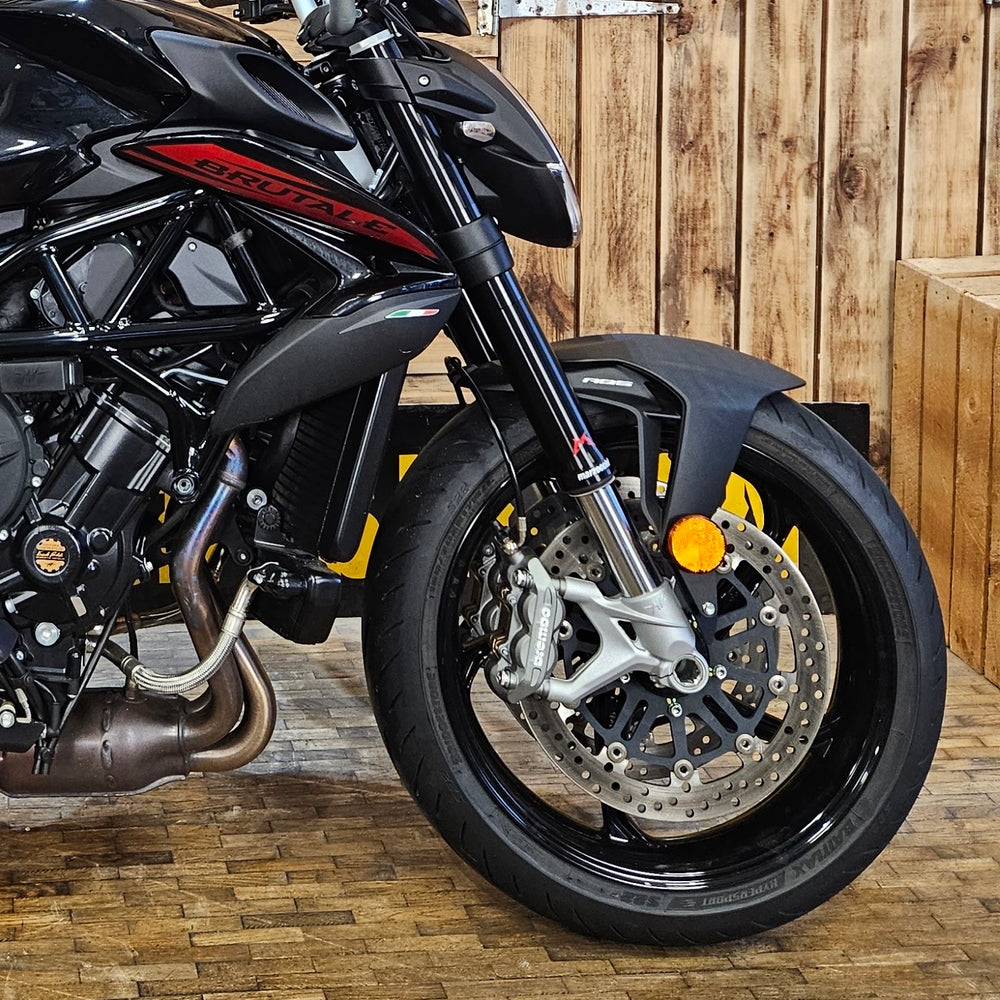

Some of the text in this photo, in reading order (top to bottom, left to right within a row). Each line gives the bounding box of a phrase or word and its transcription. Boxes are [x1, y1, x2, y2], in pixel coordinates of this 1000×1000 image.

[193, 158, 397, 236] BRUTALE
[533, 606, 551, 667] brembo
[699, 876, 780, 906] HYPERSPORT
